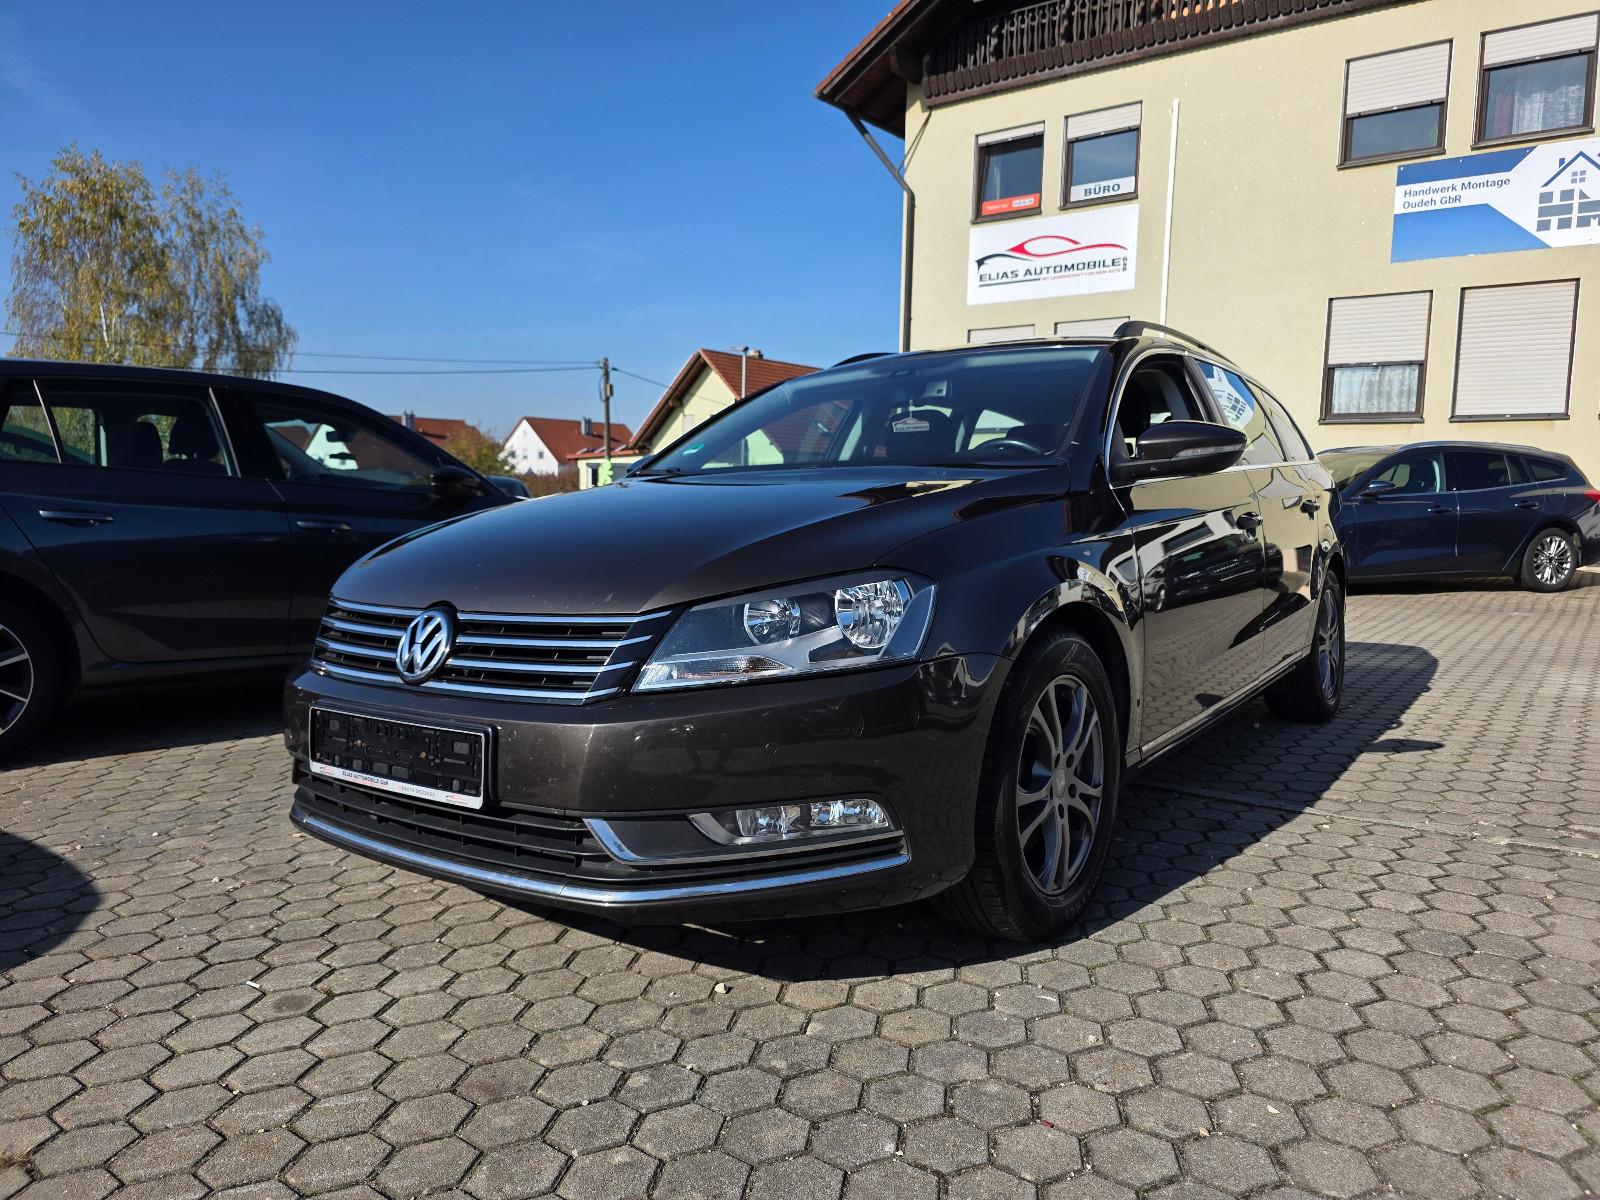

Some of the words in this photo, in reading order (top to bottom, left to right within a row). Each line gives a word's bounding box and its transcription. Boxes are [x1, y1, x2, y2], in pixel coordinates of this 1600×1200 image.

[1083, 183, 1121, 198] BÜRO
[1403, 183, 1458, 198] Handwerk
[1460, 177, 1511, 191] Montage
[1402, 196, 1437, 209] Oudeh
[1439, 194, 1462, 205] GbR
[979, 269, 1019, 283] ELIAS
[1023, 257, 1121, 277] AUTOMOBILE
